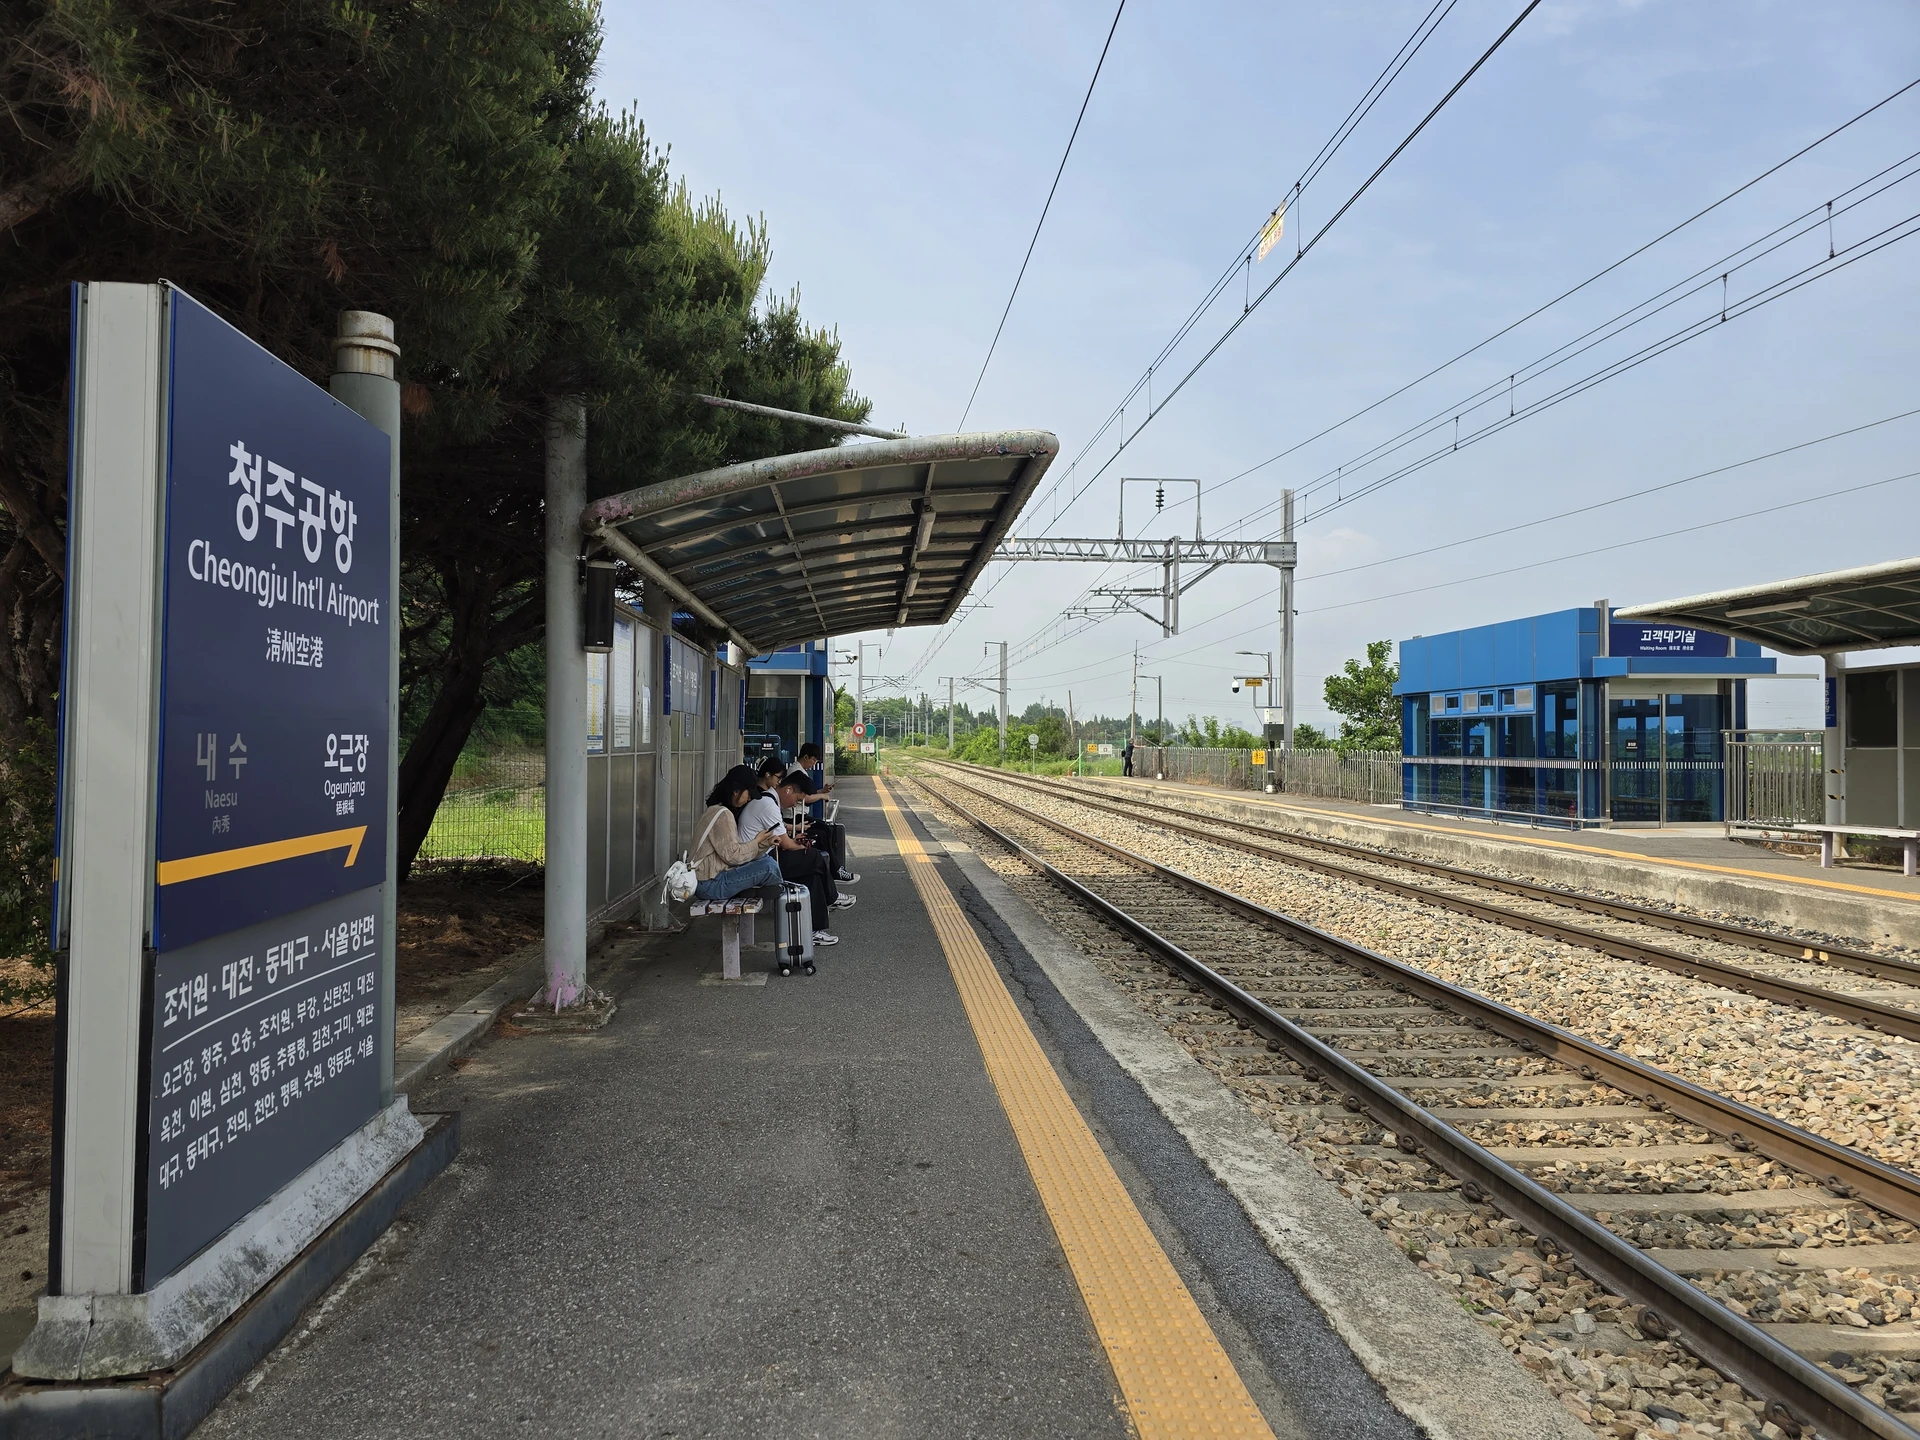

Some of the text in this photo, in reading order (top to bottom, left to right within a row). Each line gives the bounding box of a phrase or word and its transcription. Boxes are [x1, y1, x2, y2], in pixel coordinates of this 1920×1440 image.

[229, 440, 357, 574] 청주공항
[188, 539, 379, 627] Cheongju Int'l Airport
[1641, 630, 1696, 643] 고객대기실
[324, 733, 369, 773] 오근장
[324, 778, 365, 800] Ogeunjang
[205, 789, 238, 809] Naesu
[163, 973, 208, 1028] 조치원
[222, 956, 253, 1000] 대전
[266, 935, 309, 984] 동대구
[161, 1107, 185, 1143] 옥천,
[190, 1088, 216, 1121] 이원,
[220, 1071, 246, 1106] 심천,
[250, 1055, 275, 1087] 영동,
[277, 1036, 309, 1072] 추풍령,
[356, 1003, 374, 1028] 왜관
[162, 1057, 197, 1098] 오근장,
[201, 1041, 227, 1075] 청주,
[231, 1027, 256, 1055] 오송,
[259, 1007, 294, 1040] 조치원,
[297, 996, 320, 1024] 부강,
[357, 971, 374, 996] 대전
[159, 1153, 183, 1190] 대구,
[186, 1125, 223, 1171] 동대구,
[227, 1108, 251, 1144] 전의,
[254, 1091, 278, 1126] 천안,
[304, 1063, 325, 1092] 수원,
[327, 1046, 355, 1078] 영등포,
[357, 1034, 374, 1059] 서울
